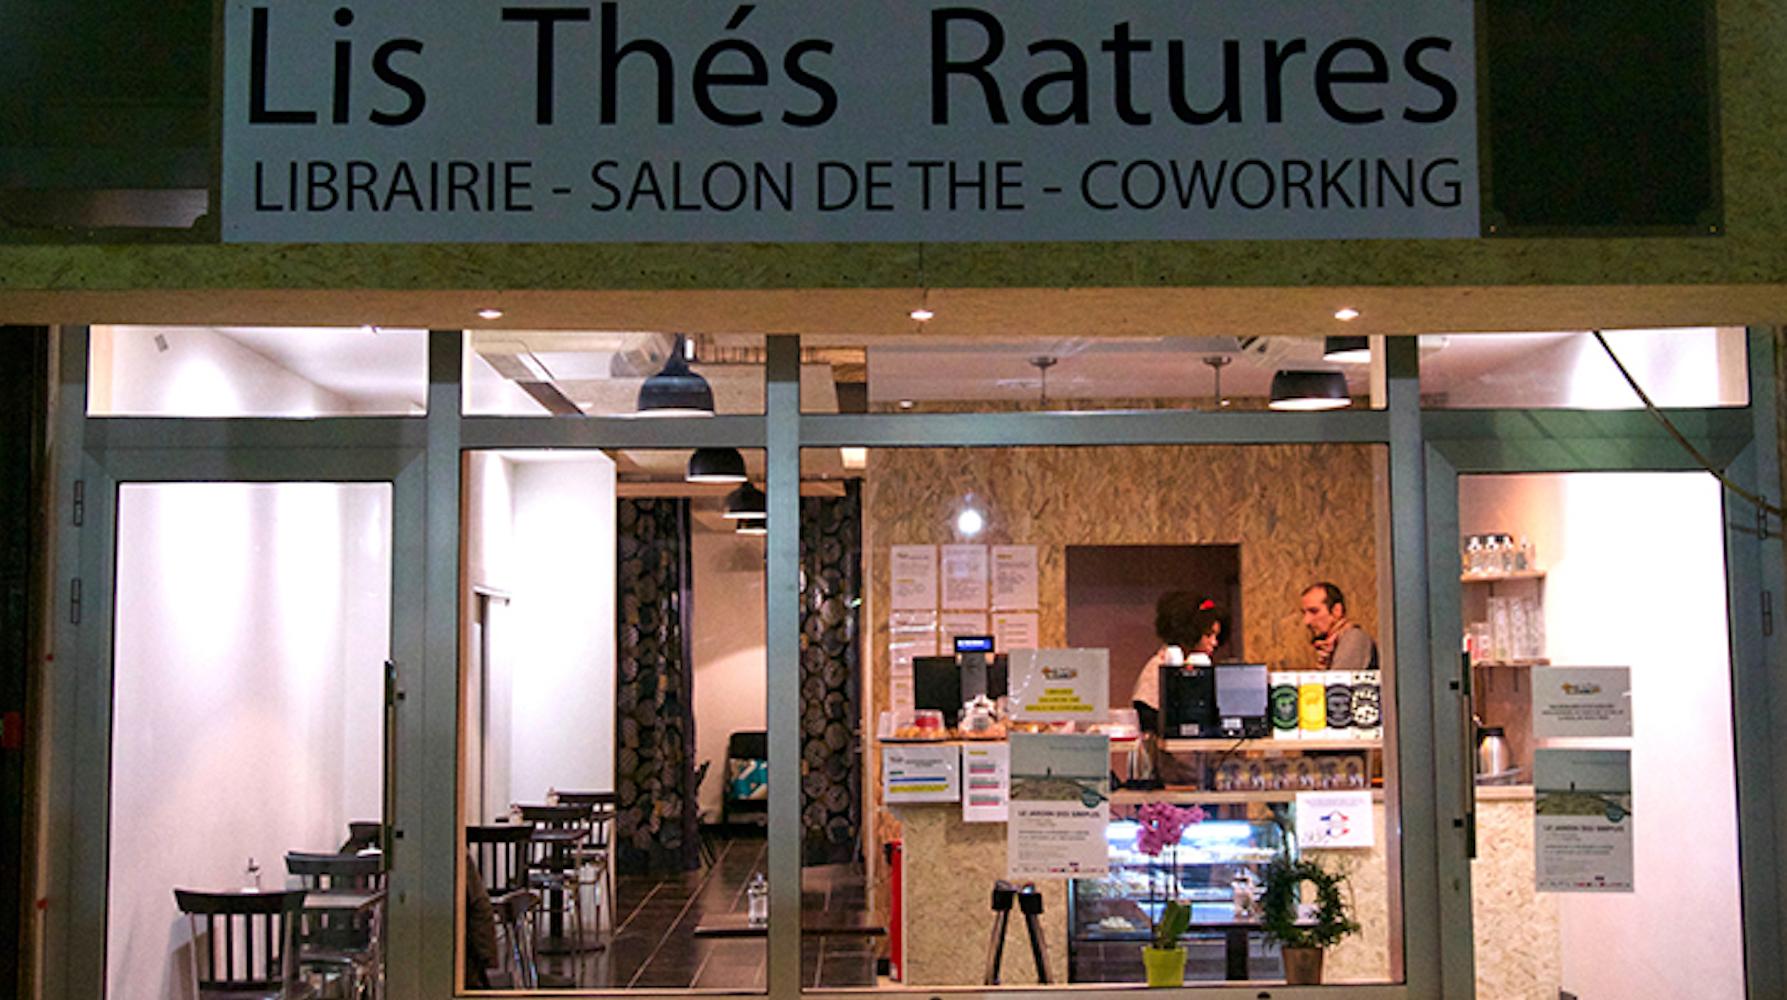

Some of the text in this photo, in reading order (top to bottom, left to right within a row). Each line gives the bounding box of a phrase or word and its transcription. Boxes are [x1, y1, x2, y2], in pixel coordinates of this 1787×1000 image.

[248, 1, 1459, 128] Lis Thés Ratures
[254, 160, 534, 212] LIBRAIRIE
[590, 160, 793, 213] SALON
[817, 160, 895, 212] DE
[907, 160, 1025, 211] THE
[1080, 157, 1462, 211] COWORKING
